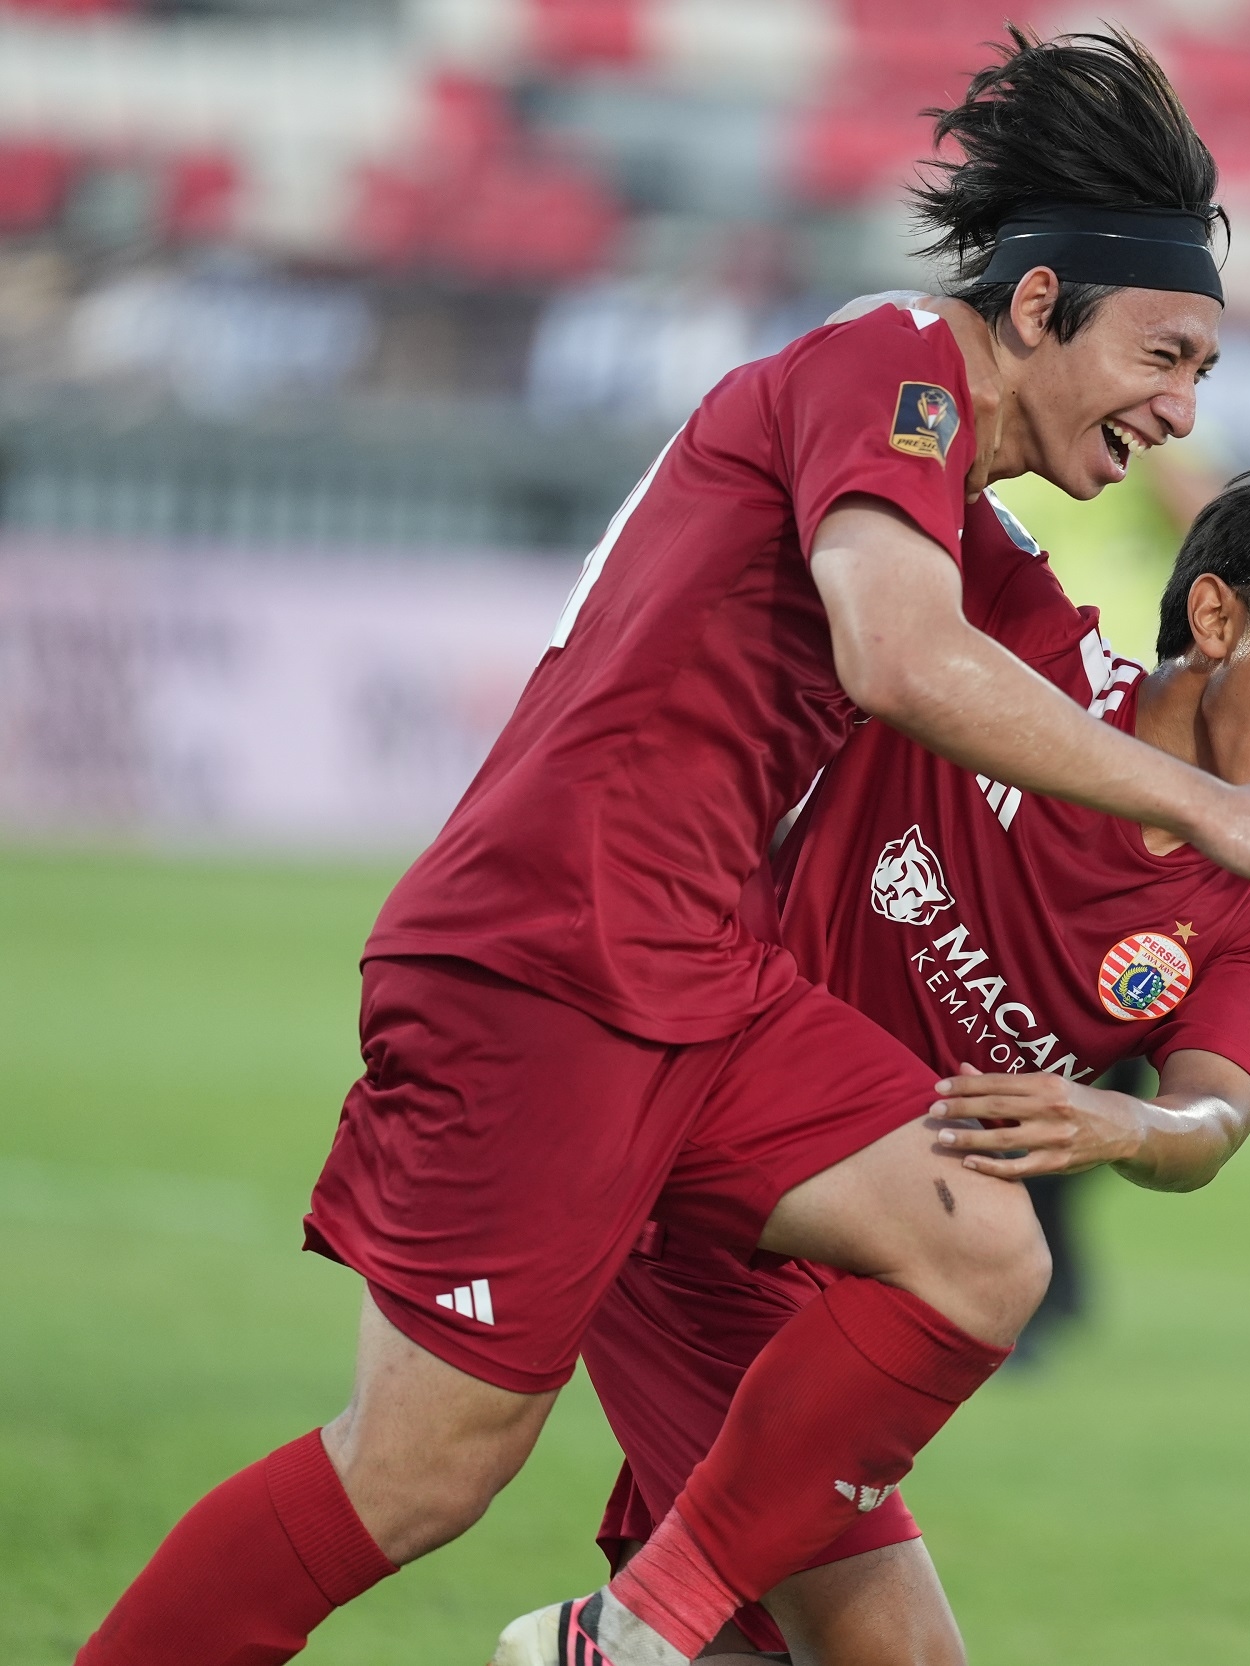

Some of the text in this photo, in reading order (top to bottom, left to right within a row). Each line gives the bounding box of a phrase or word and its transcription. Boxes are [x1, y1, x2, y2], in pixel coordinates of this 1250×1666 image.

[1142, 936, 1187, 973] PERSIJA
[1142, 951, 1174, 977] JAYA RAYA
[910, 948, 1026, 1075] KEMAYOR
[932, 923, 1094, 1081] MACAN
